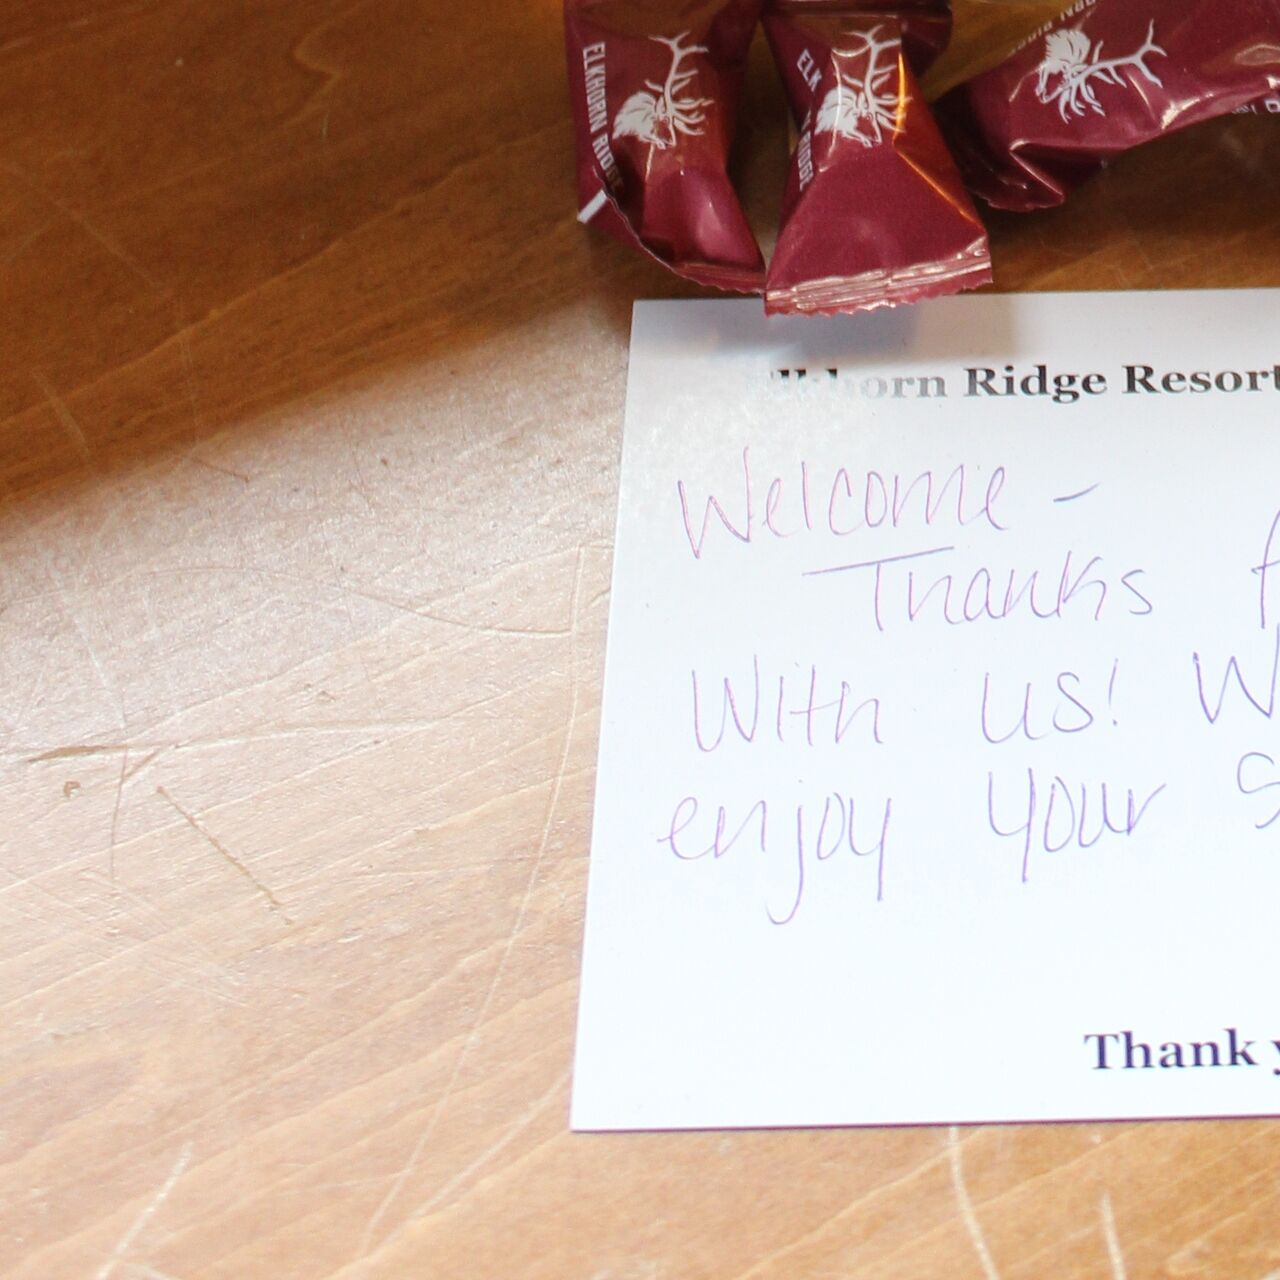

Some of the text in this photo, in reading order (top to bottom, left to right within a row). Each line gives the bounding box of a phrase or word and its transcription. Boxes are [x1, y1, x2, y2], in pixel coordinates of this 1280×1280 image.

[582, 42, 607, 133] ELKHORN
[964, 364, 1108, 404] Ridge
[677, 446, 1012, 560] Welcome
[657, 778, 893, 926] enjoy
[1082, 1026, 1260, 1072] Thank
